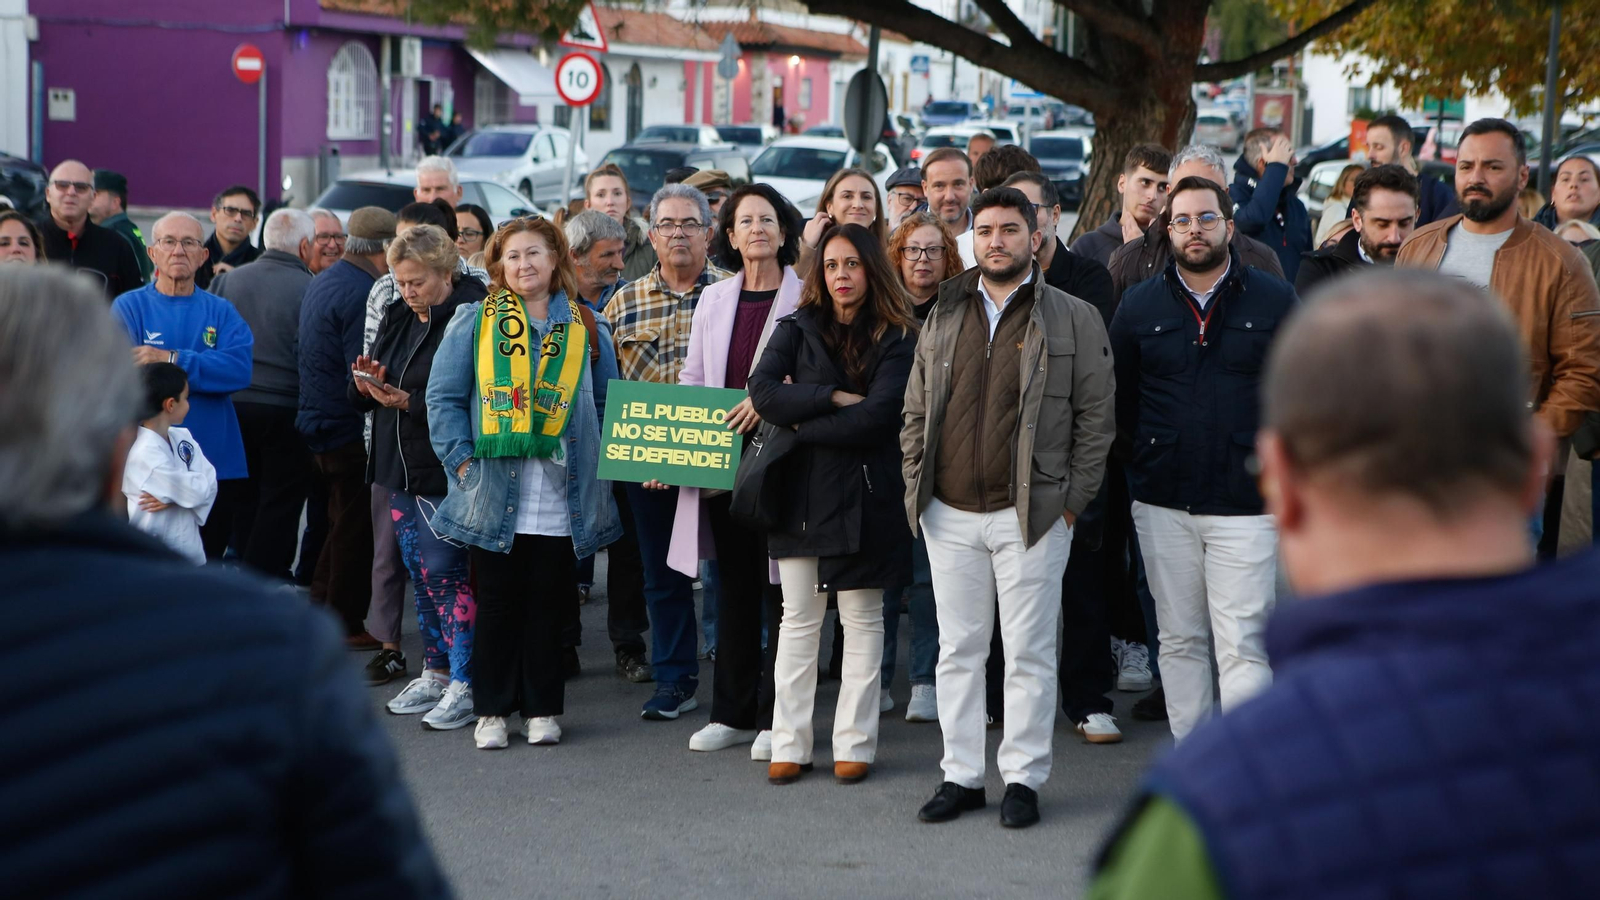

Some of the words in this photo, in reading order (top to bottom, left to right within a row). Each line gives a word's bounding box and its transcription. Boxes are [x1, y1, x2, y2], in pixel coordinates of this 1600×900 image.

[568, 71, 589, 89] 10
[497, 289, 526, 356] RIOS
[654, 404, 728, 425] PUEBLO
[612, 422, 641, 440] NO
[643, 425, 668, 442] SE
[670, 427, 733, 447] VENDE
[606, 444, 631, 461] SE
